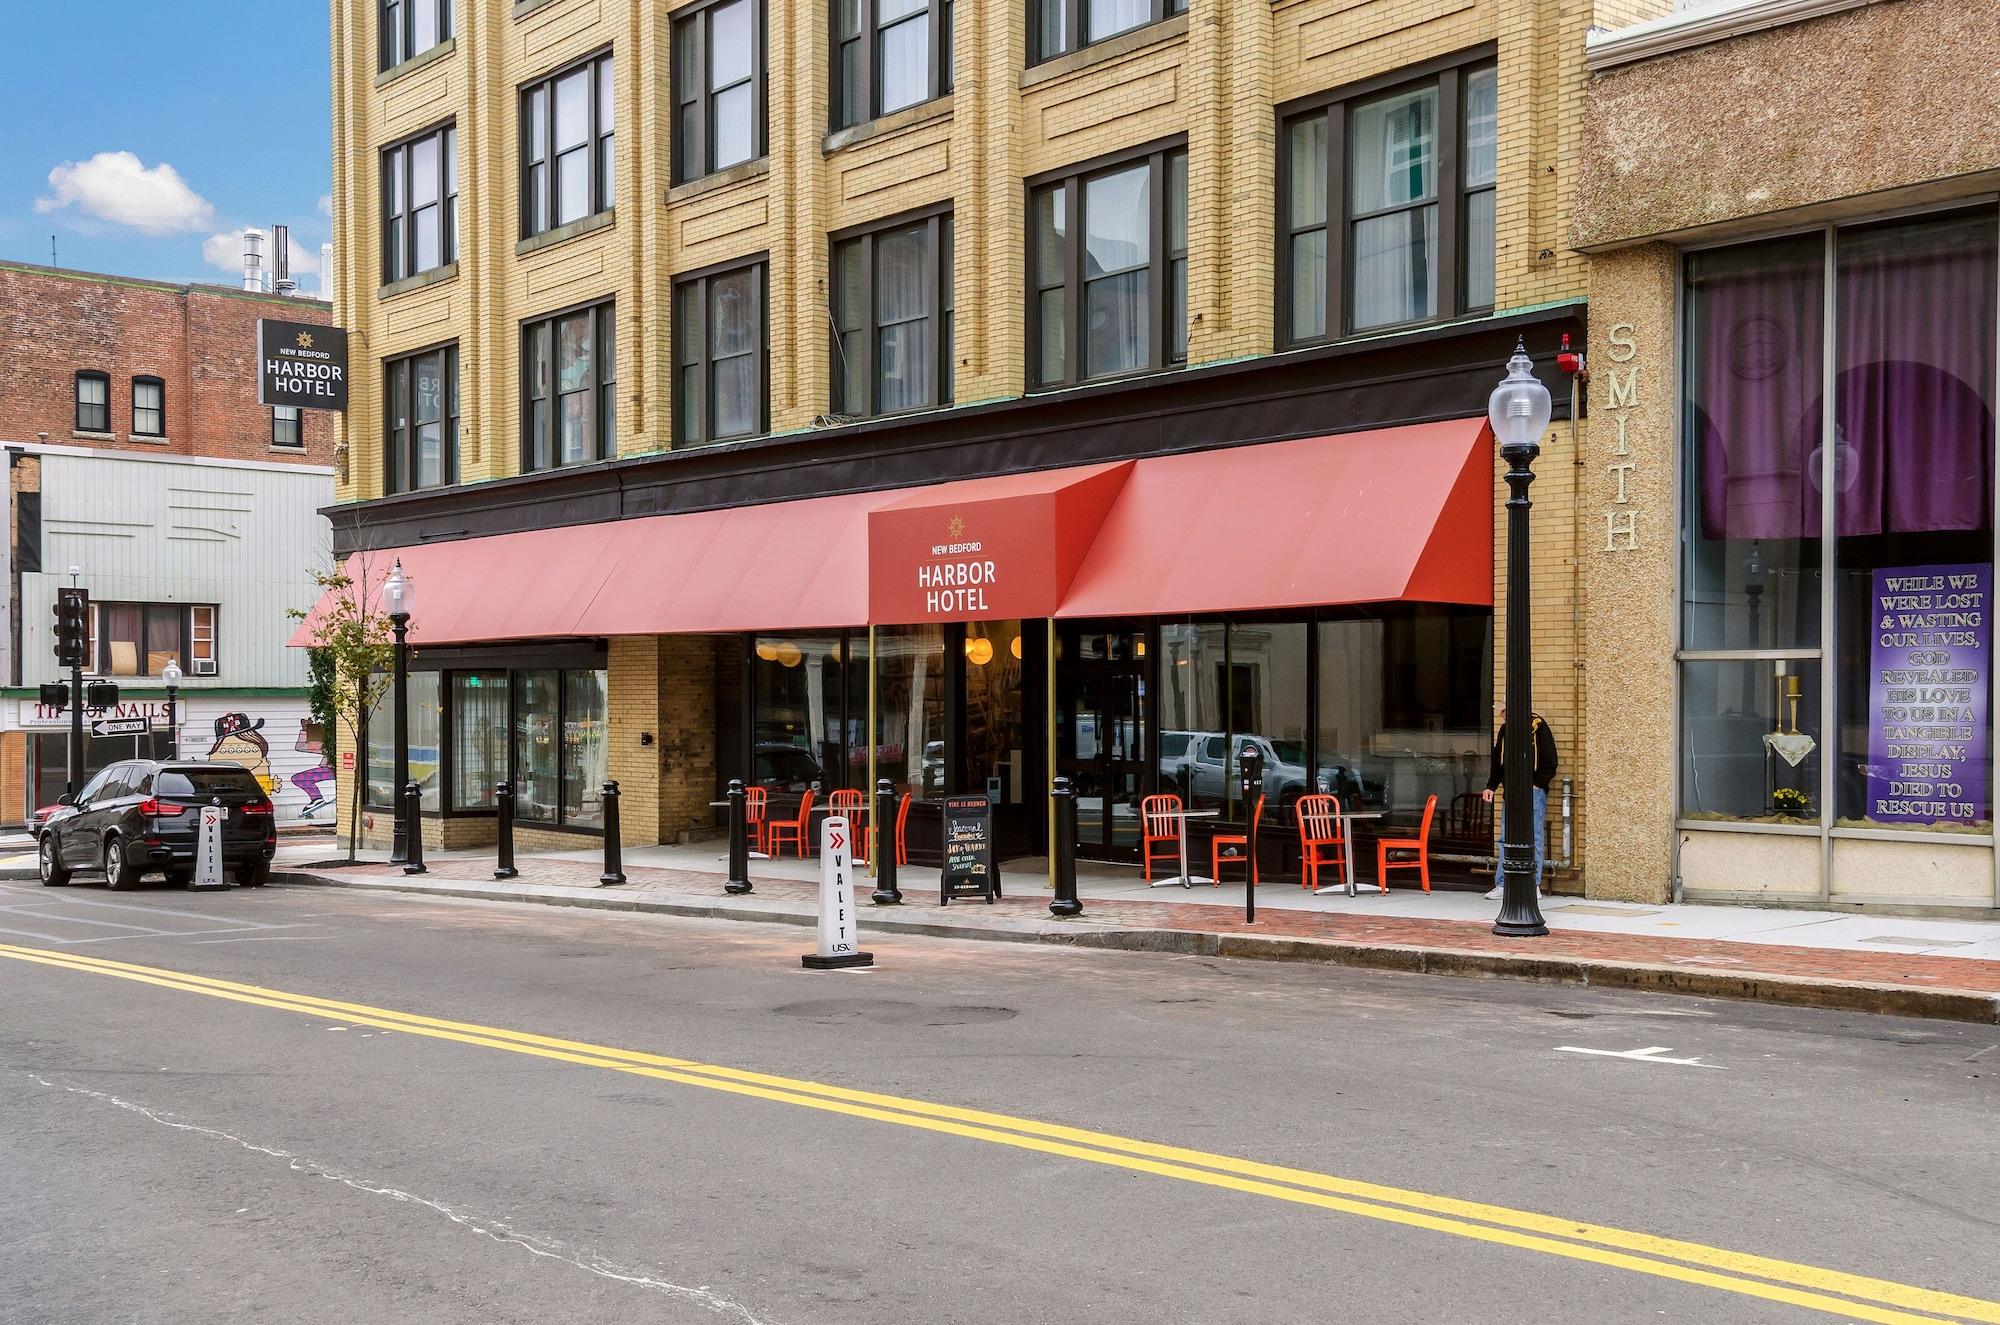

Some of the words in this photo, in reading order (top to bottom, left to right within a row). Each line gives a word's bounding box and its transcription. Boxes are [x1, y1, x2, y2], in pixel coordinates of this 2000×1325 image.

[280, 348, 297, 356] NEW
[298, 349, 330, 359] BEDFORD
[266, 359, 342, 381] HARBOR
[275, 376, 335, 396] HOTEL
[1604, 322, 1641, 552] SMITH
[932, 543, 948, 555] NEW
[949, 541, 982, 554] BEDFORD
[918, 561, 996, 588] HARBOR
[1885, 576, 1944, 592] WHILE
[1948, 574, 1978, 589] WE
[927, 588, 989, 613] HOTEL
[1880, 595, 1931, 610] WERE
[1935, 593, 1983, 609] LOST
[1880, 615, 1895, 629] &
[1898, 612, 1982, 629] WASTING
[1880, 632, 1919, 648] OUR
[1922, 631, 1980, 648] LIVES,
[1908, 650, 1950, 666] GOD
[1880, 669, 1979, 685] REVEALED
[1886, 688, 1917, 703] HIS
[1920, 688, 1971, 703] LOVE
[114, 703, 171, 718] NAILS
[1882, 707, 1907, 722] TO
[1909, 707, 1935, 722] US
[1937, 707, 1958, 722] IN
[1959, 707, 1976, 722] A
[108, 723, 123, 731] ONE
[125, 722, 142, 730] WAY
[1882, 725, 1973, 741] TANGIBLE
[1887, 744, 1966, 762] DISPLAY;
[1900, 763, 1952, 779] JESUS
[1889, 782, 1934, 797] DIED
[1937, 783, 1962, 798] TO
[1876, 800, 1947, 817] RESCUE
[1949, 802, 1974, 818] US
[835, 855, 845, 939] VALET
